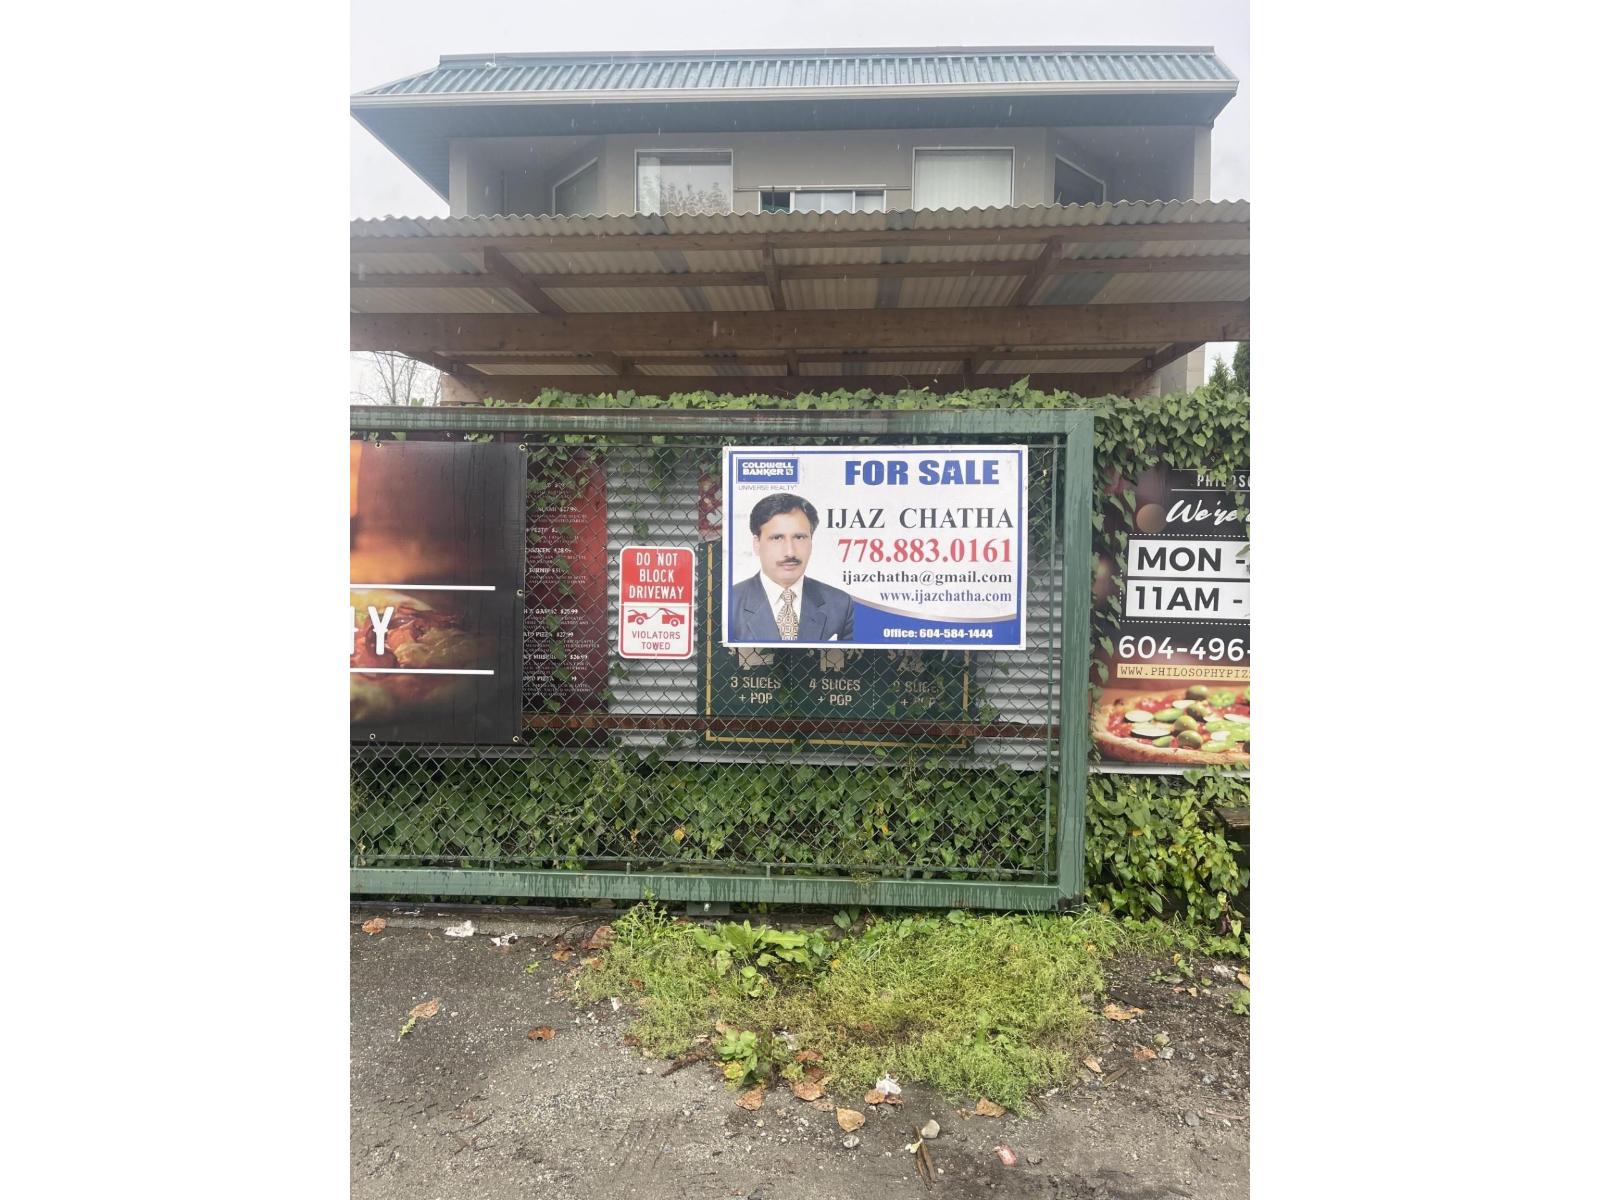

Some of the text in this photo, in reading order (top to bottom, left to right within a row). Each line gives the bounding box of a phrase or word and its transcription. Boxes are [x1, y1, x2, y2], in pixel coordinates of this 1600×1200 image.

[742, 468, 784, 476] BANKER
[845, 459, 999, 486] FOR SALE
[827, 507, 1014, 529] IJAZ CHATHA
[1166, 499, 1238, 526] We're
[838, 538, 1012, 563] 778.883.0161
[636, 552, 678, 566] DO NOT
[1137, 547, 1222, 571] MON
[640, 569, 674, 582] BLOCK
[842, 570, 1012, 586] ijazchatha@gmail.com
[629, 585, 685, 600] DRIVEWAY
[880, 589, 1012, 604] www.ijazchatha.com
[1135, 586, 1220, 612] 11AM
[631, 631, 681, 640] VIOLATORS
[883, 628, 993, 638] Office: 604-584-1444
[641, 641, 671, 650] TOWED
[1118, 635, 1250, 662] 604-496
[1120, 666, 1250, 679] WWW.PHILOSOPHYPIZ
[731, 677, 781, 689] 3 SLICES
[809, 679, 861, 691] 4 SLICES
[750, 692, 773, 704] POP
[829, 694, 853, 706] POP
